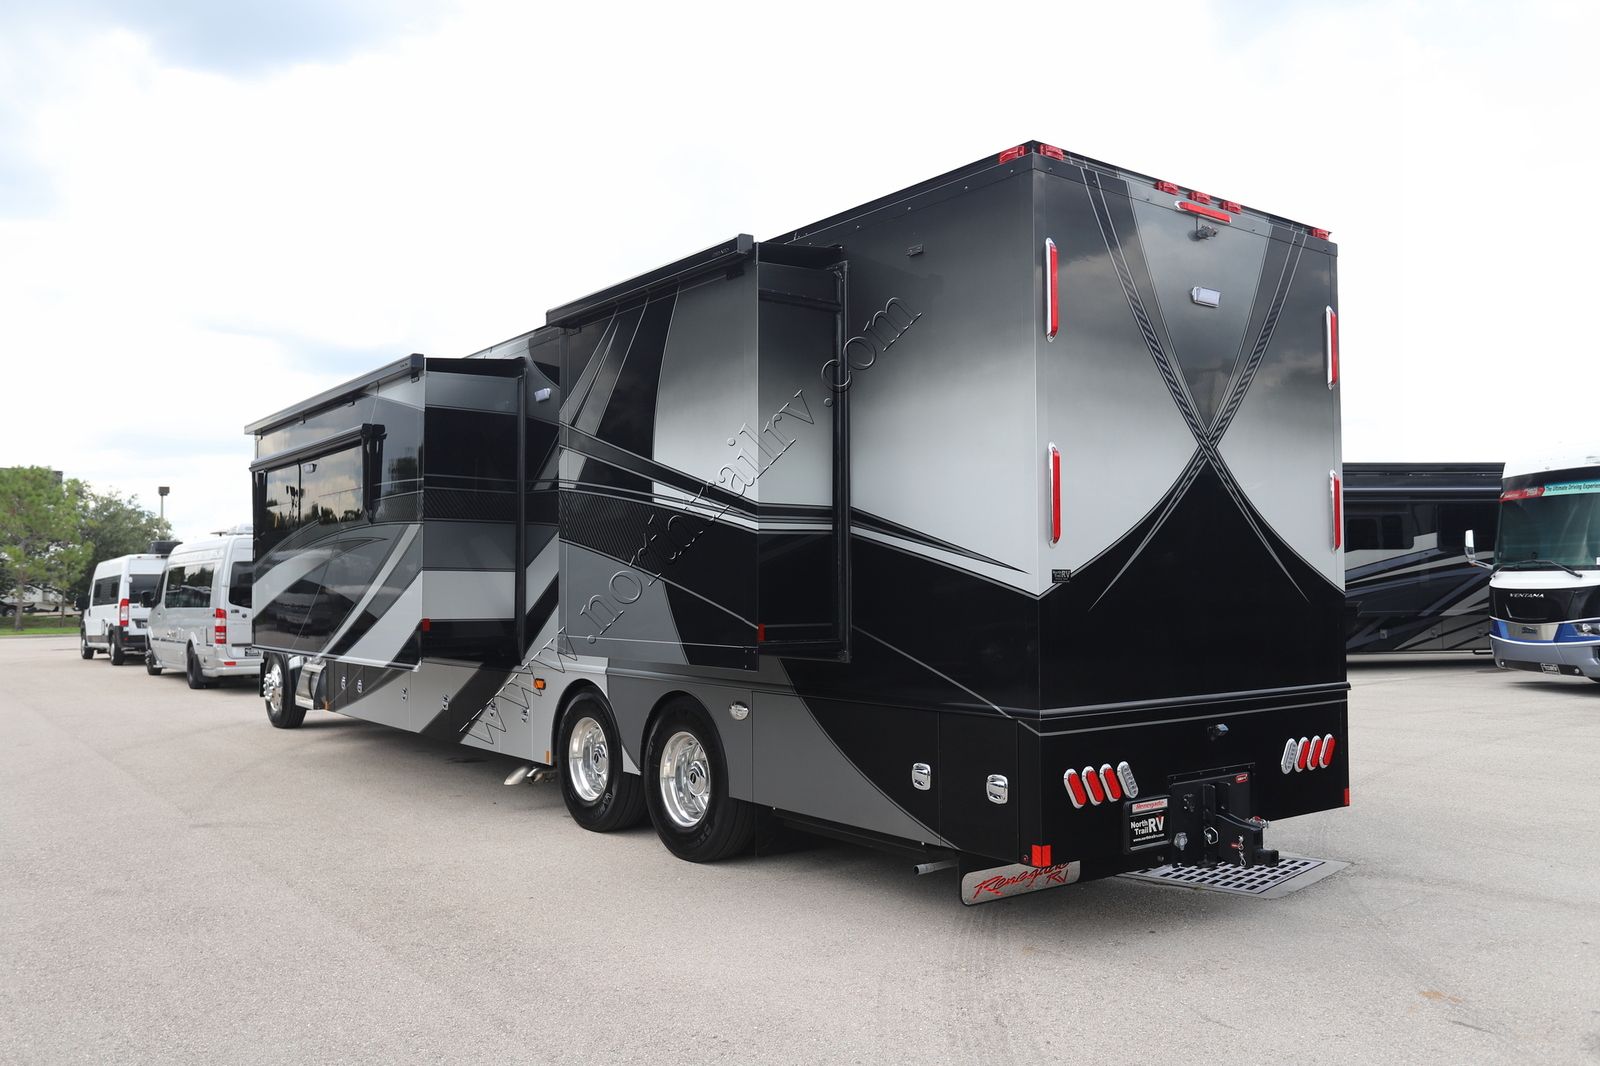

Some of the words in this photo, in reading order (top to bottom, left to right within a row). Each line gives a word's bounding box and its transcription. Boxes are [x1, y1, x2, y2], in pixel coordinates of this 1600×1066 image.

[1062, 570, 1071, 578] RV
[1131, 819, 1148, 829] North
[1148, 816, 1164, 833] RV
[1134, 827, 1148, 835] Trail
[1046, 869, 1068, 885] RV
